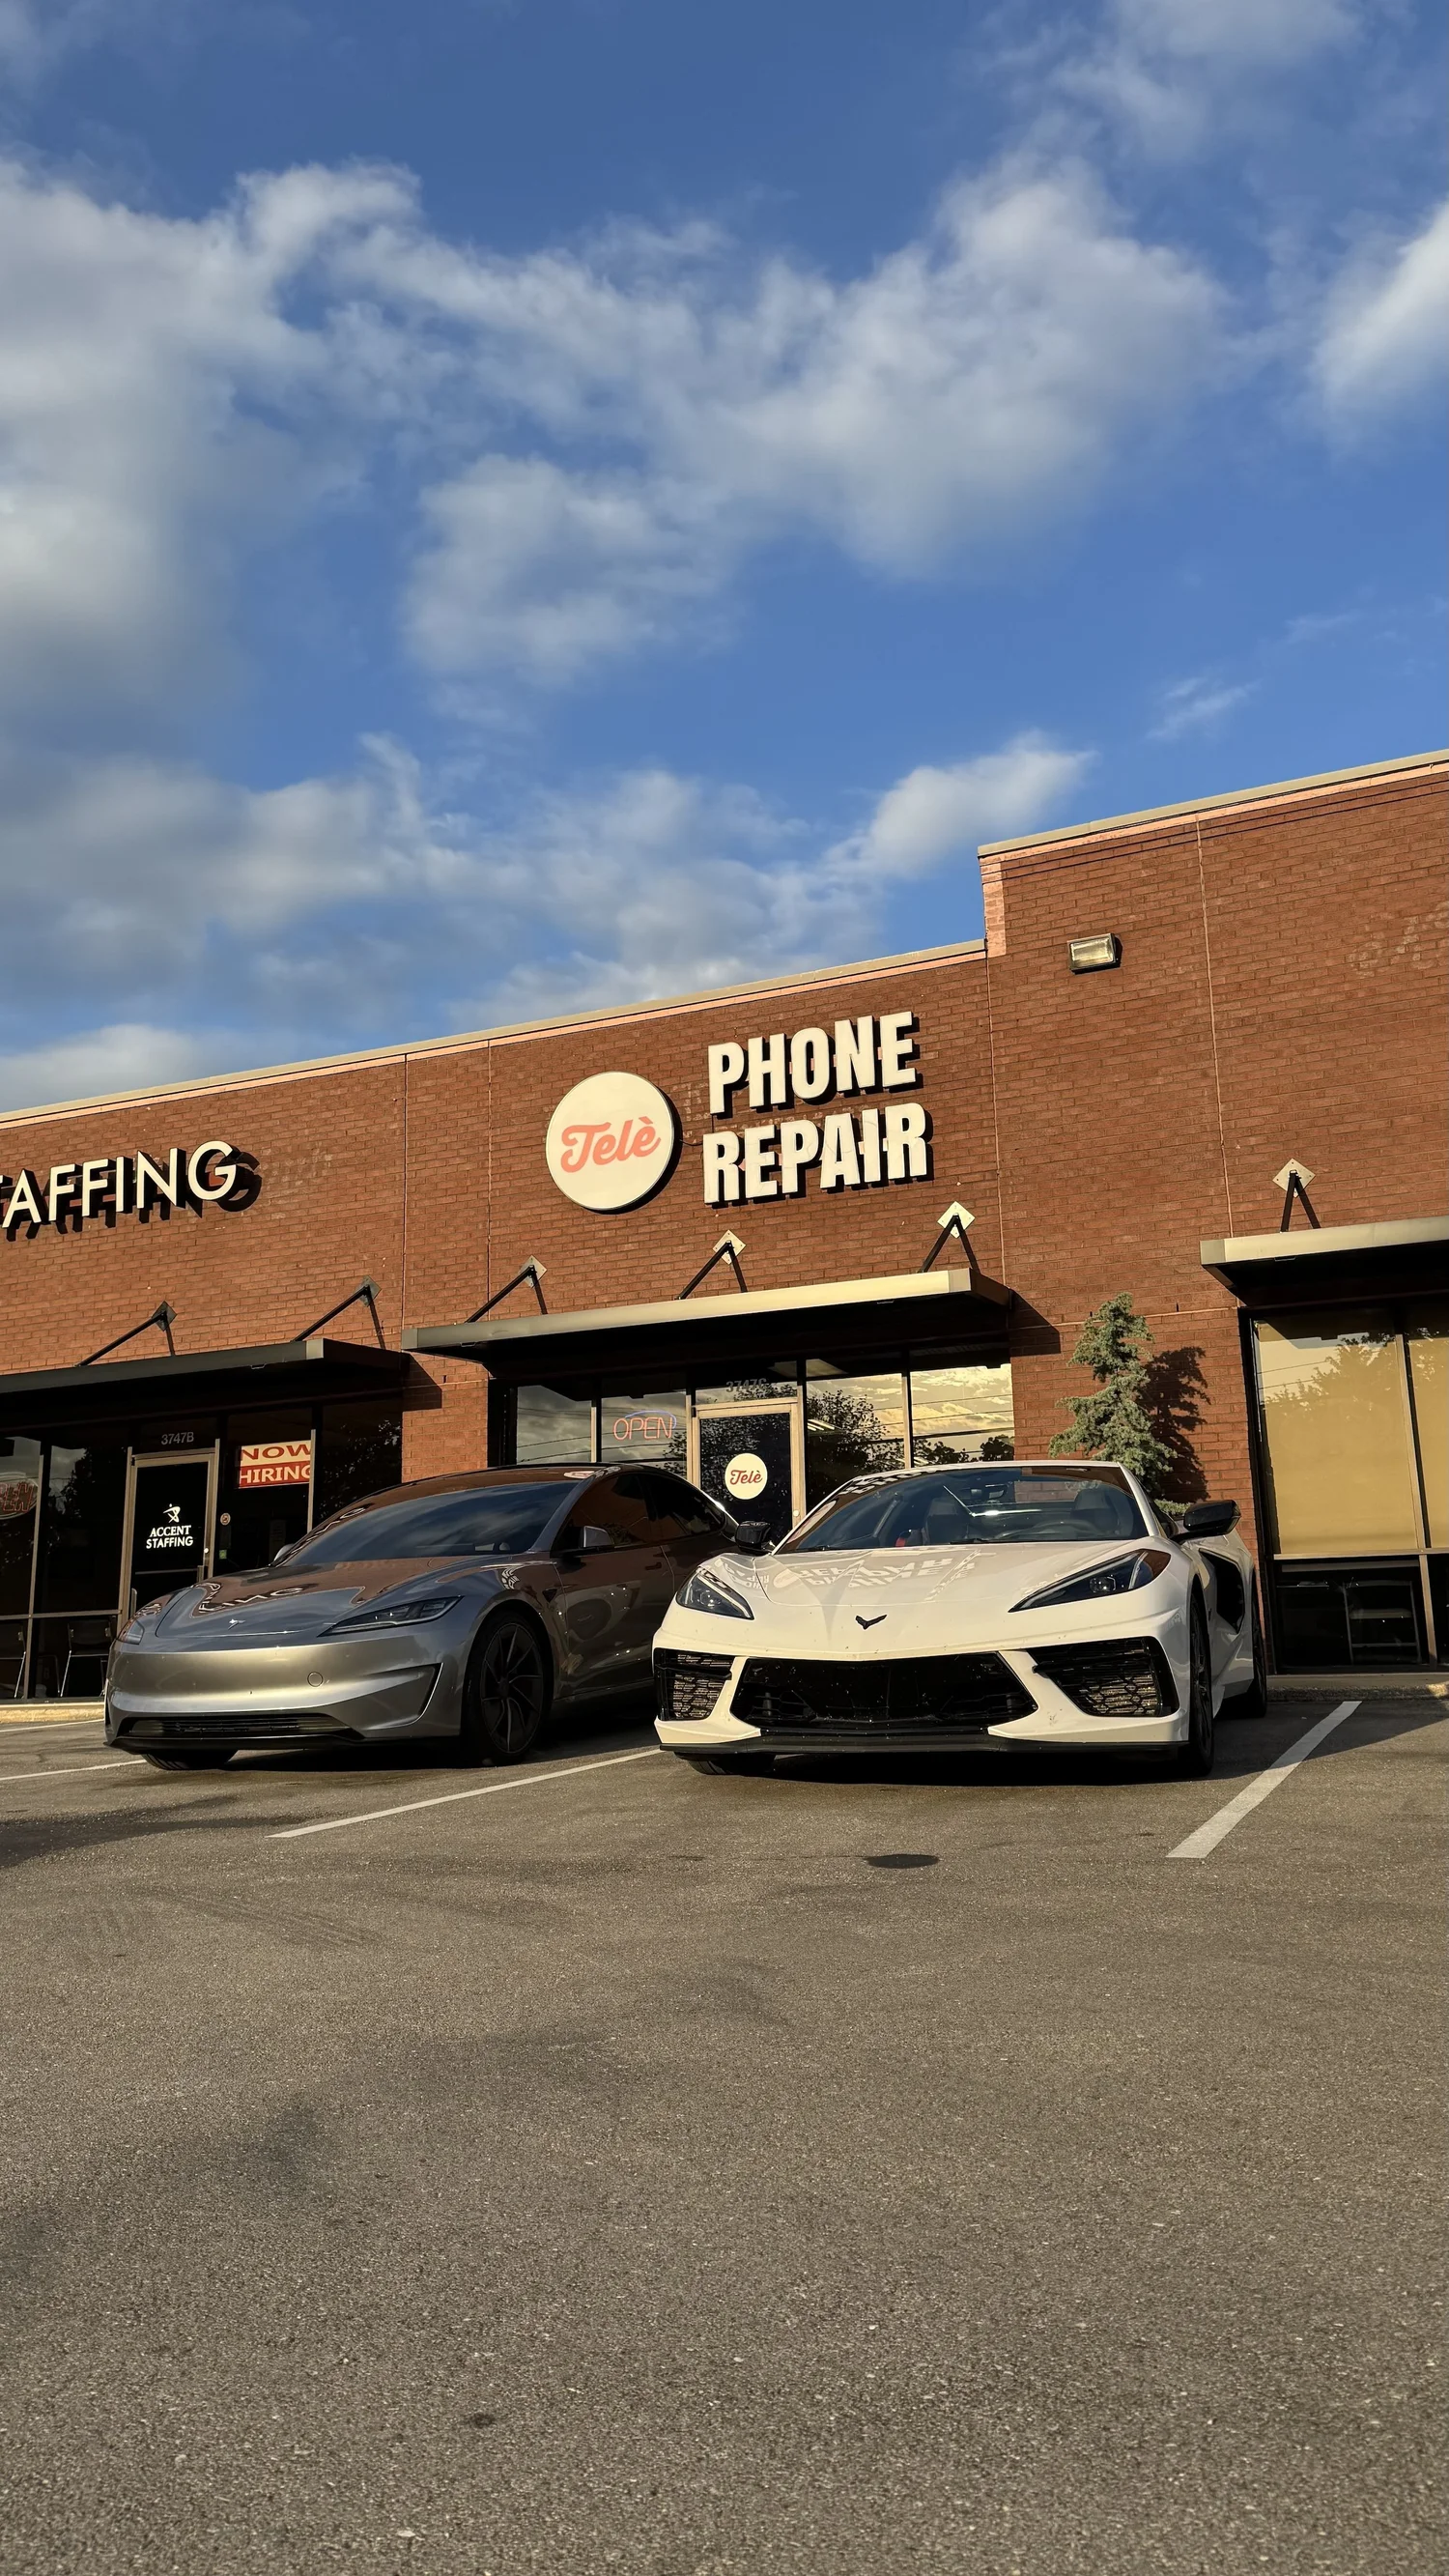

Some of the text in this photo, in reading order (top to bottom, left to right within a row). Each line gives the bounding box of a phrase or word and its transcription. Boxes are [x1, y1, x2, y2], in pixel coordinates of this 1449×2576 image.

[707, 1011, 917, 1115] PHONE
[560, 1116, 662, 1173] Telè
[702, 1102, 928, 1204] REPAIR
[0, 1140, 238, 1228] AFFING
[160, 1431, 195, 1445] 3747B
[612, 1416, 673, 1441] OPEN
[240, 1444, 311, 1461] NOW
[729, 1469, 763, 1485] Telè
[149, 1525, 192, 1538] ACCENT
[146, 1535, 194, 1550] STAFFING
